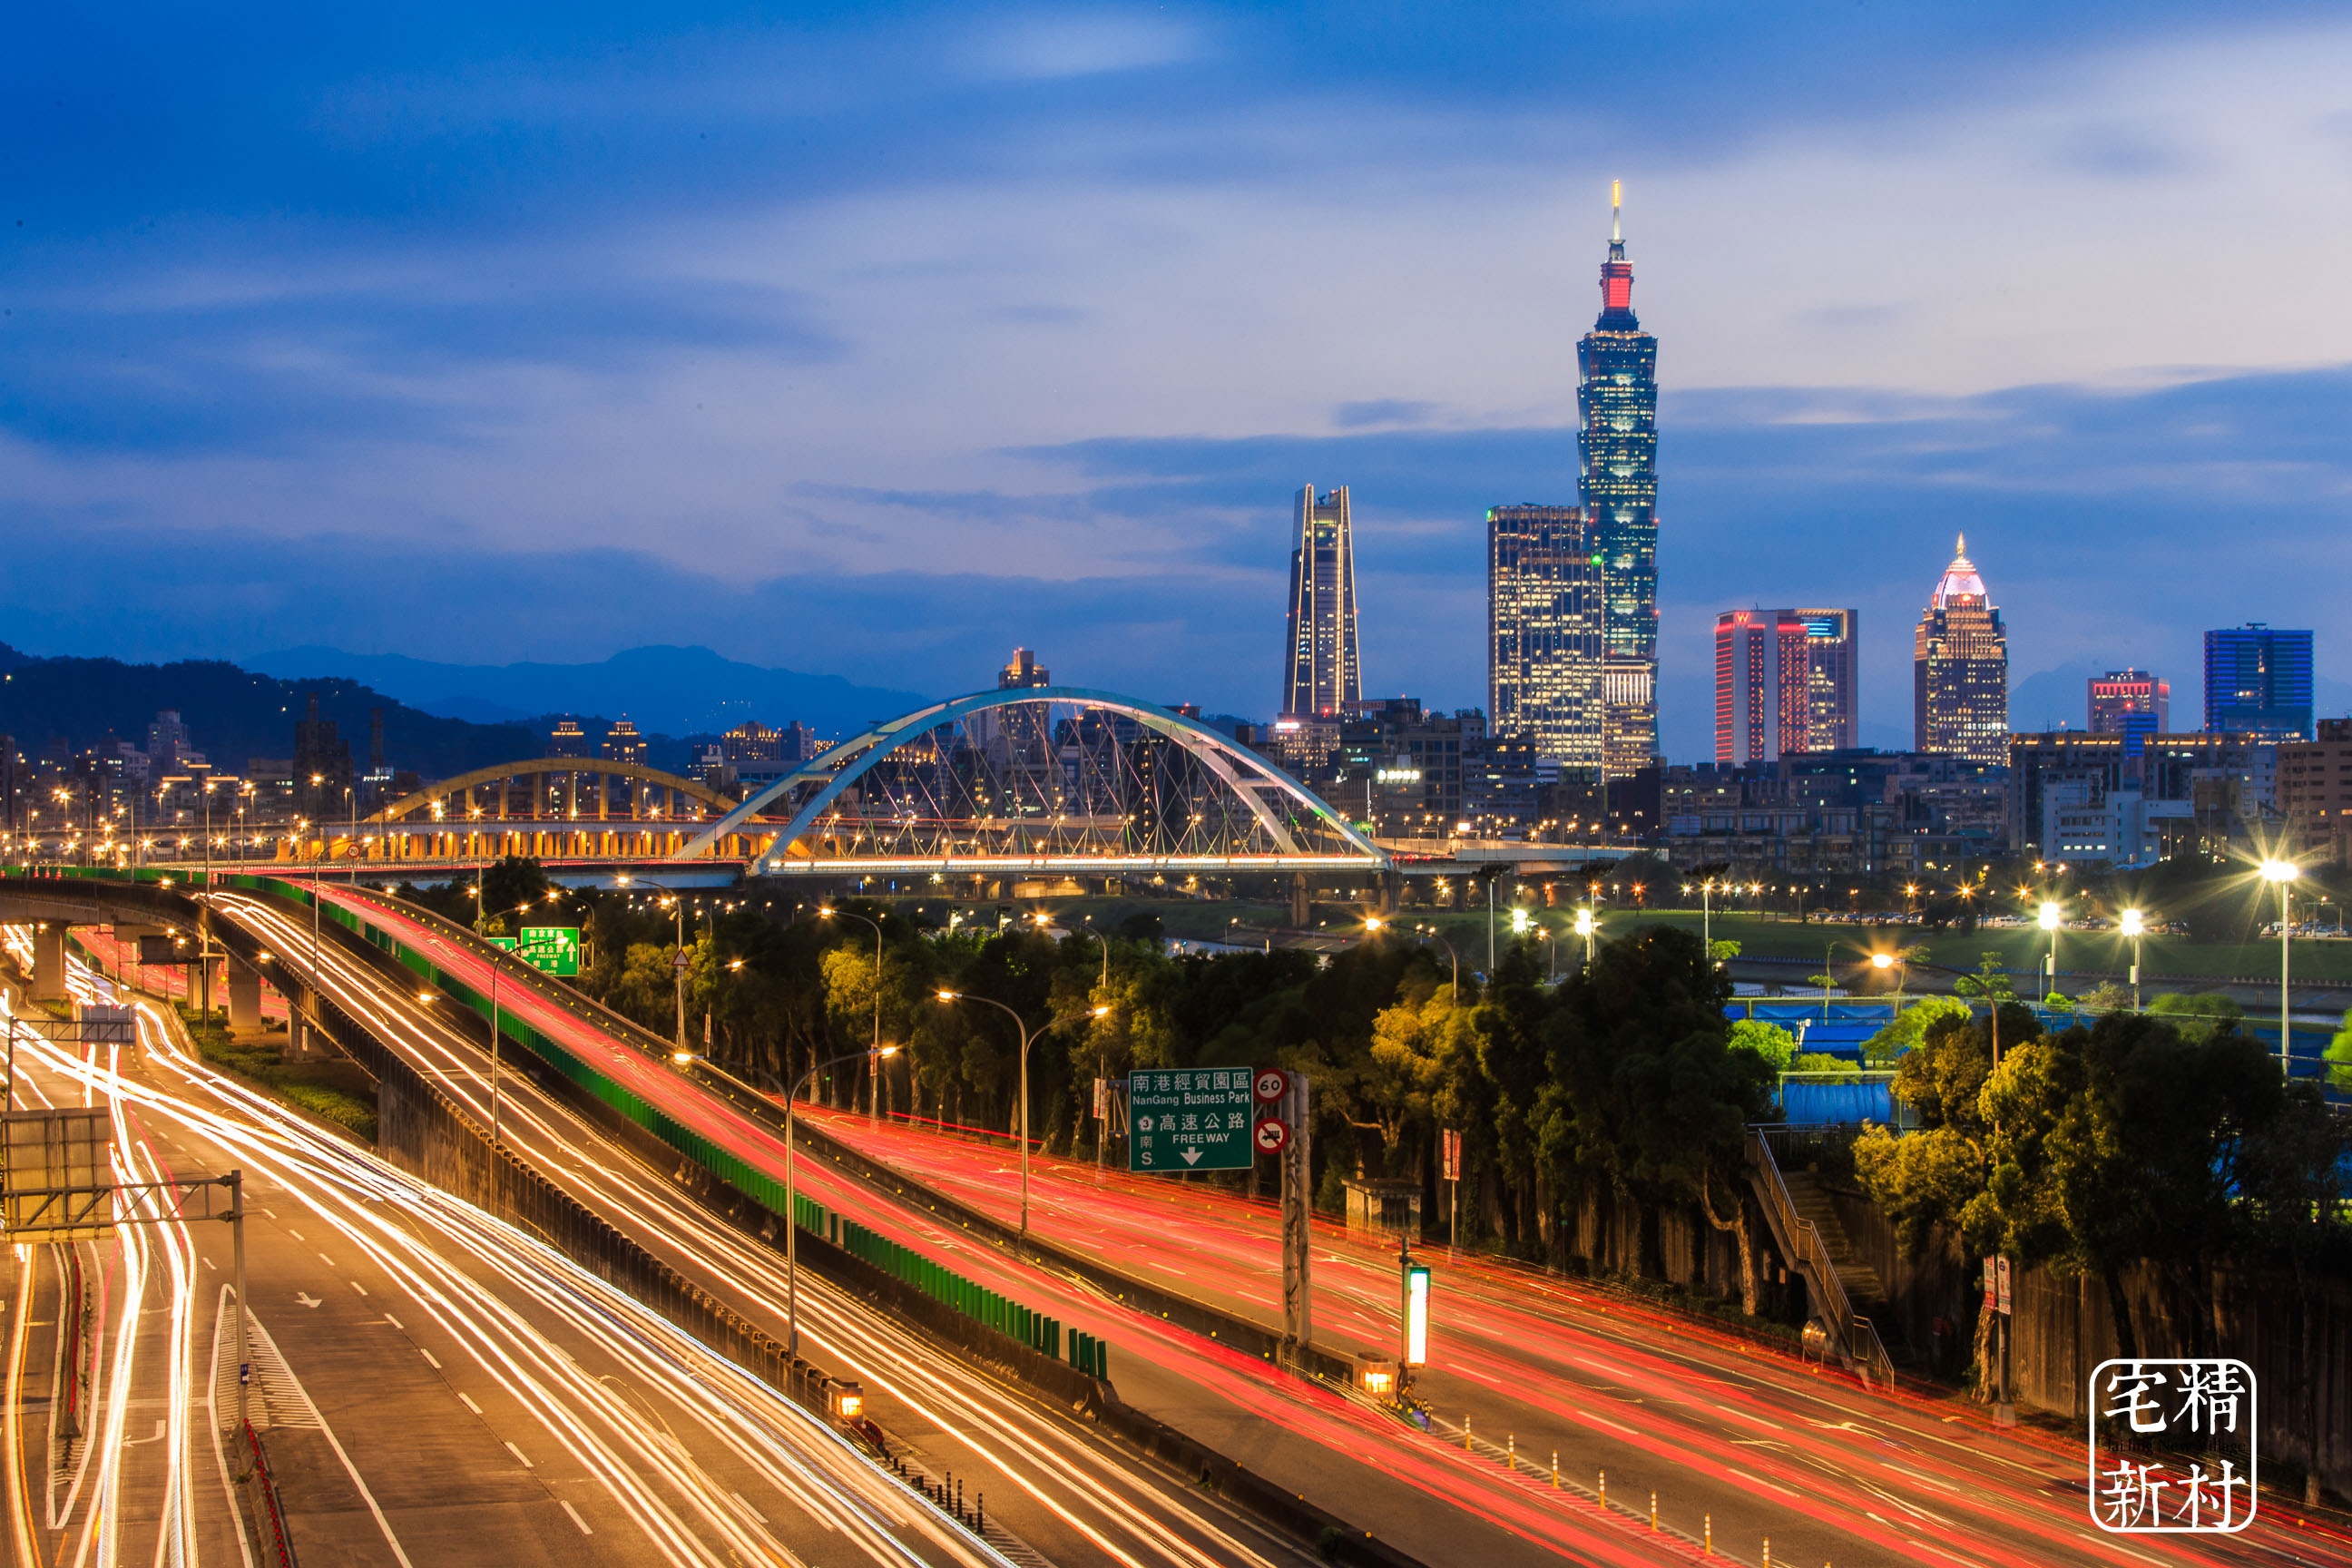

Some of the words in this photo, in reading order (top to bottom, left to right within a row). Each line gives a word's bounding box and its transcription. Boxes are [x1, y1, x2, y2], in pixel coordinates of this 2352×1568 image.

[1735, 611, 1750, 625] W
[1132, 1073, 1250, 1092] 南港經貿園區
[1259, 1080, 1280, 1092] 60
[1132, 1094, 1180, 1106] NanGang
[1184, 1092, 1225, 1104] Business
[1228, 1091, 1250, 1103] Park
[1160, 1112, 1245, 1132] 高速公路
[1140, 1135, 1152, 1149] 南
[1172, 1132, 1230, 1144] FREEWAY
